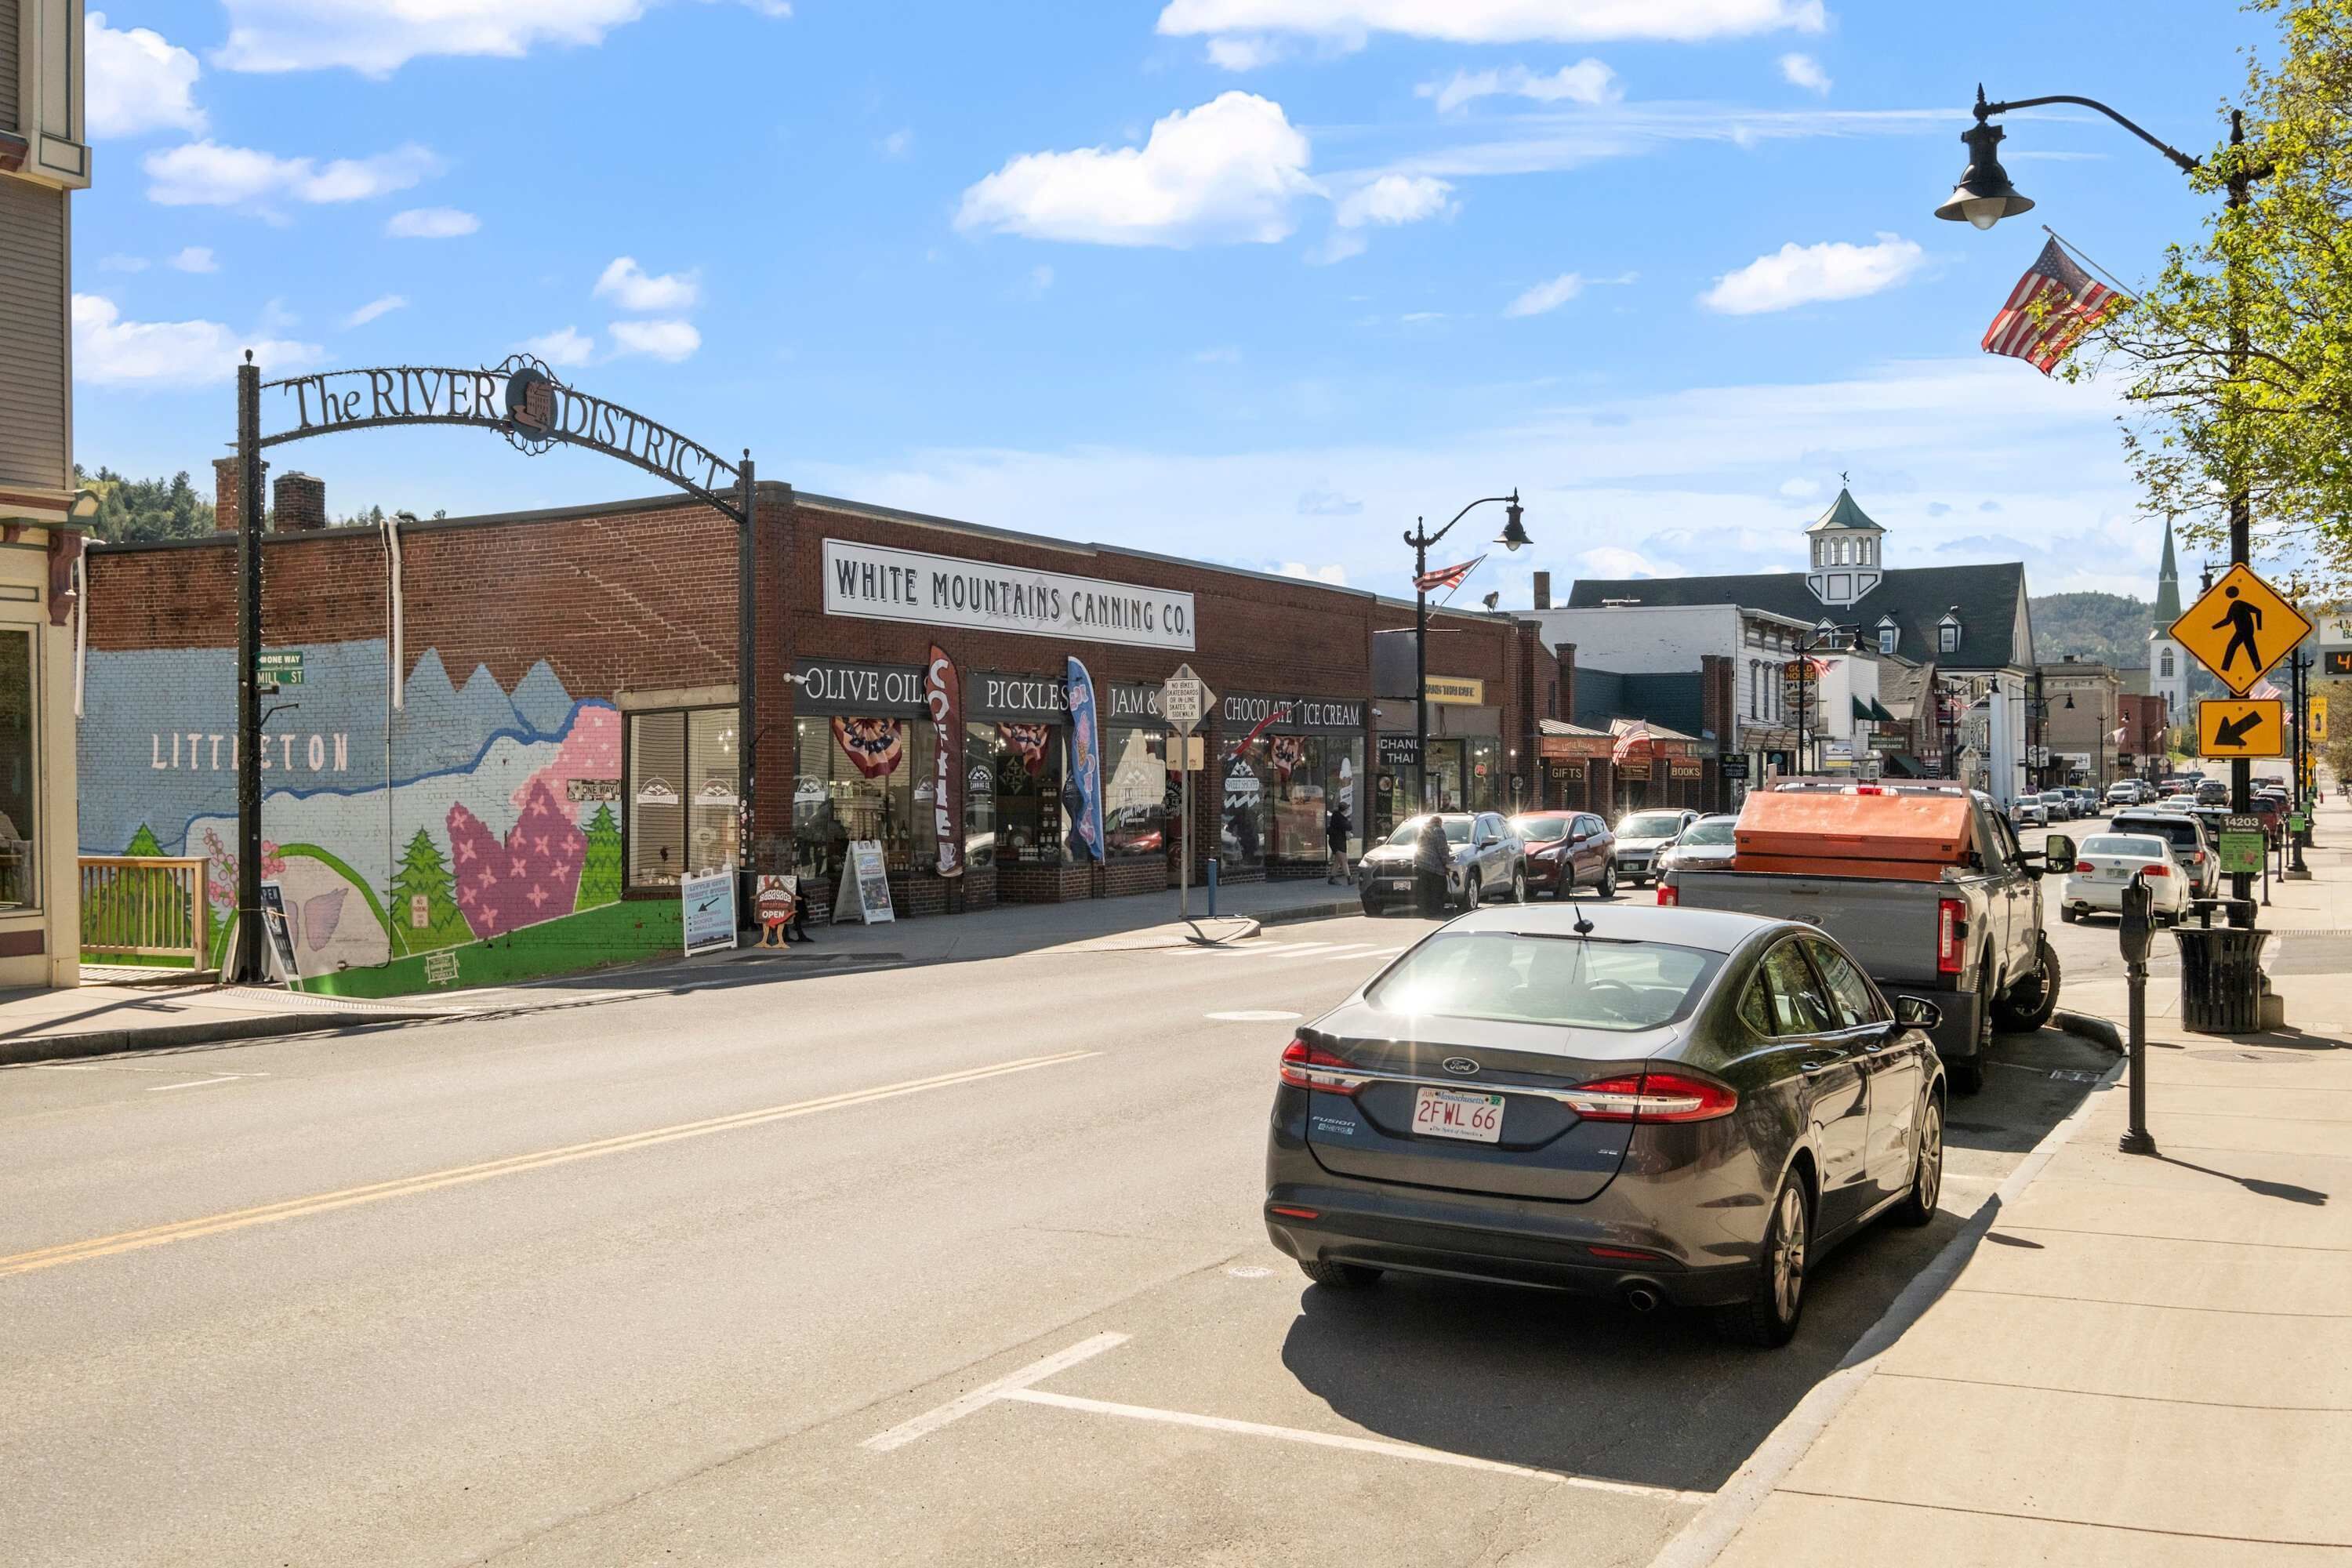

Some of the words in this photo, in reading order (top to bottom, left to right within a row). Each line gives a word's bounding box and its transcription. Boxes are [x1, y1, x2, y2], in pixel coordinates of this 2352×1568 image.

[284, 376, 361, 430] The
[365, 368, 499, 419] RIVER
[562, 390, 726, 492] DISTRICT
[835, 558, 917, 606] WHITE
[932, 572, 1061, 622] MOUNTAINS
[1071, 590, 1155, 633] CANNING
[1163, 604, 1191, 637] CO.
[267, 655, 283, 664] ONE
[283, 655, 300, 664] WAY
[257, 671, 278, 684] MILL
[291, 670, 303, 683] ST
[805, 667, 880, 701] OLIVE
[986, 681, 1069, 711] PICKLES
[1111, 688, 1145, 717] JAM
[1146, 690, 1159, 715] &
[1224, 697, 1293, 724] CHOCOLATE
[1303, 703, 1321, 725] ICE
[1323, 704, 1360, 725] CREAM
[1386, 753, 1414, 764] THAI
[1552, 768, 1582, 779] GIFTS
[1671, 768, 1700, 776] BOOKS
[583, 784, 597, 793] ONE
[599, 785, 615, 794] WAY
[2223, 817, 2259, 826] 14203
[762, 910, 785, 919] OPEN
[1450, 1060, 1472, 1071] Ford
[1436, 1091, 1485, 1105] Massachusetts
[1417, 1100, 1465, 1127] 2FWL
[1472, 1106, 1497, 1130] 66
[1312, 1116, 1356, 1127] FUSION
